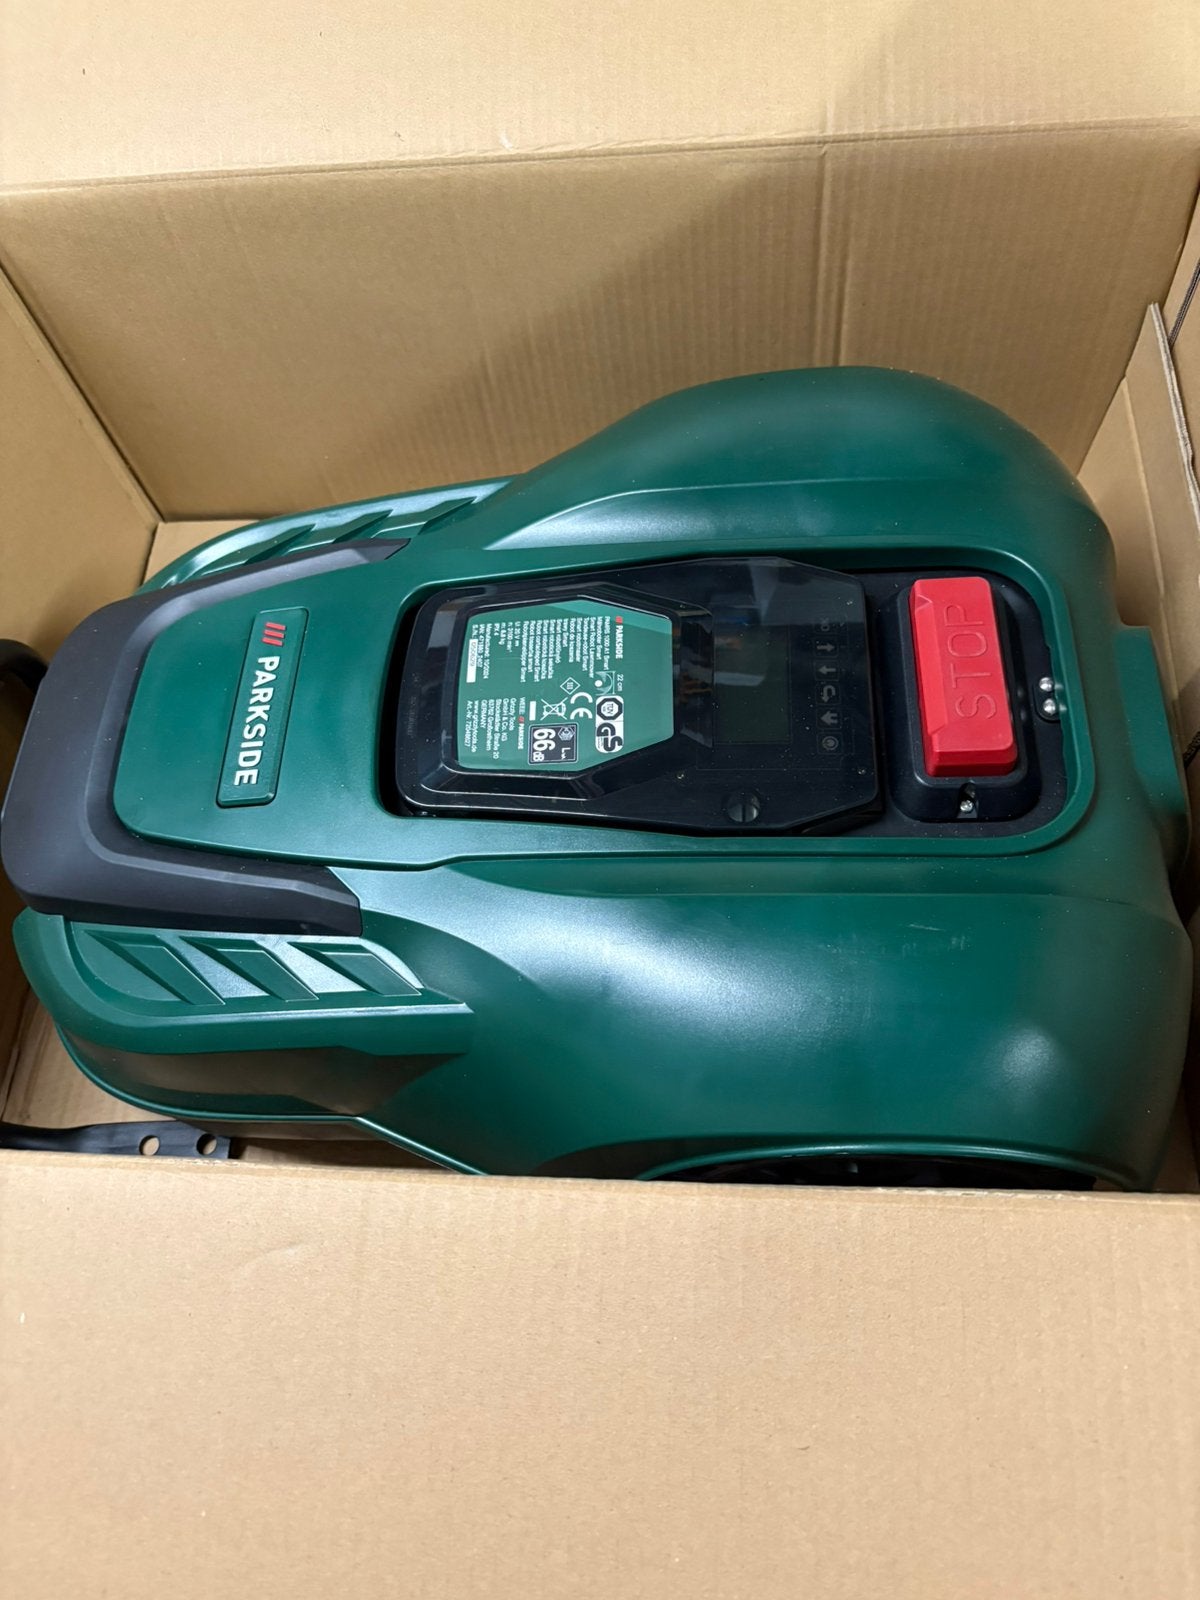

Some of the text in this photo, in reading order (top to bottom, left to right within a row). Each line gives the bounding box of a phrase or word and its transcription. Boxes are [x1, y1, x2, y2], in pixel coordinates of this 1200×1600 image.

[944, 604, 996, 719] STOP
[617, 682, 623, 692] cm
[570, 692, 593, 720] CE
[234, 656, 280, 786] PARKSIDE
[596, 722, 623, 752] GS
[493, 751, 499, 759] 20
